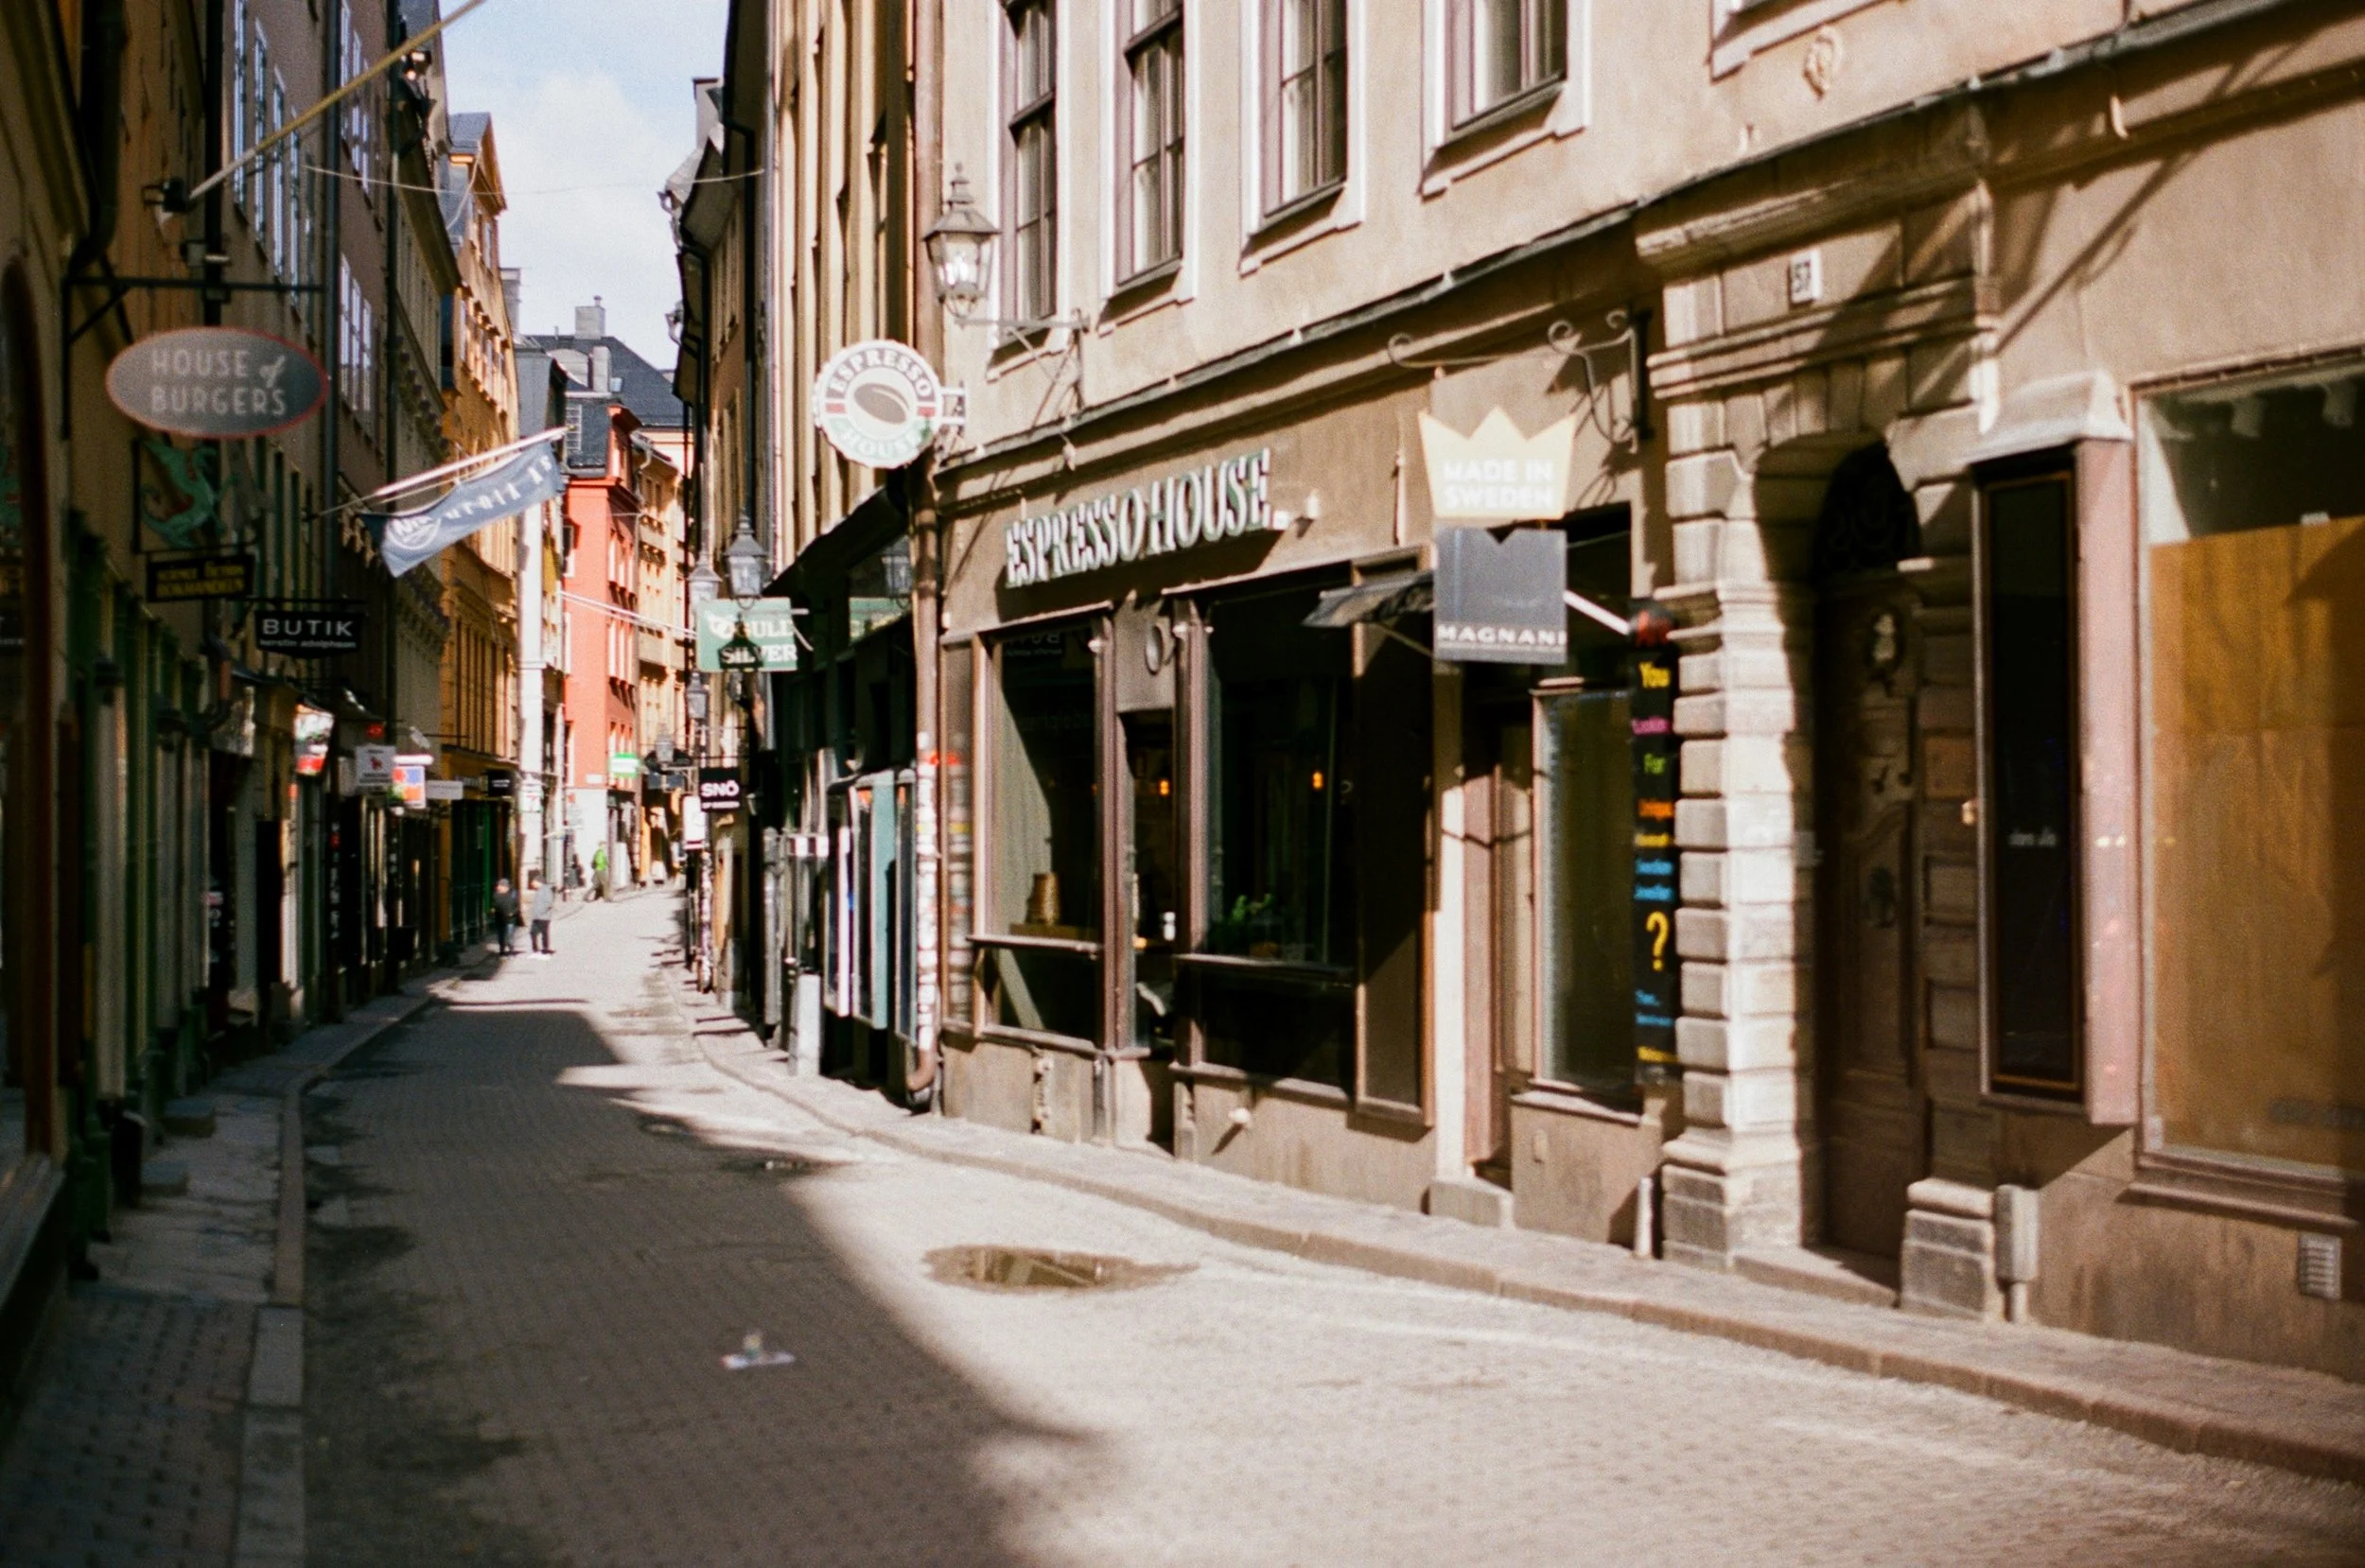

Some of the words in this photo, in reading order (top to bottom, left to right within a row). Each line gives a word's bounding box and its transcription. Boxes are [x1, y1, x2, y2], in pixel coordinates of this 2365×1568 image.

[151, 348, 250, 377] HOUSE
[259, 355, 286, 389] of
[829, 348, 934, 398] ESPRESSO
[151, 386, 287, 416] BURGERS
[1443, 459, 1515, 481] MADE
[1525, 459, 1554, 481] IN
[1442, 485, 1554, 510] SWEDEN
[1005, 486, 1147, 588] ESPRESSO
[1146, 447, 1271, 556] HOUSE
[262, 618, 354, 636] BUTIK
